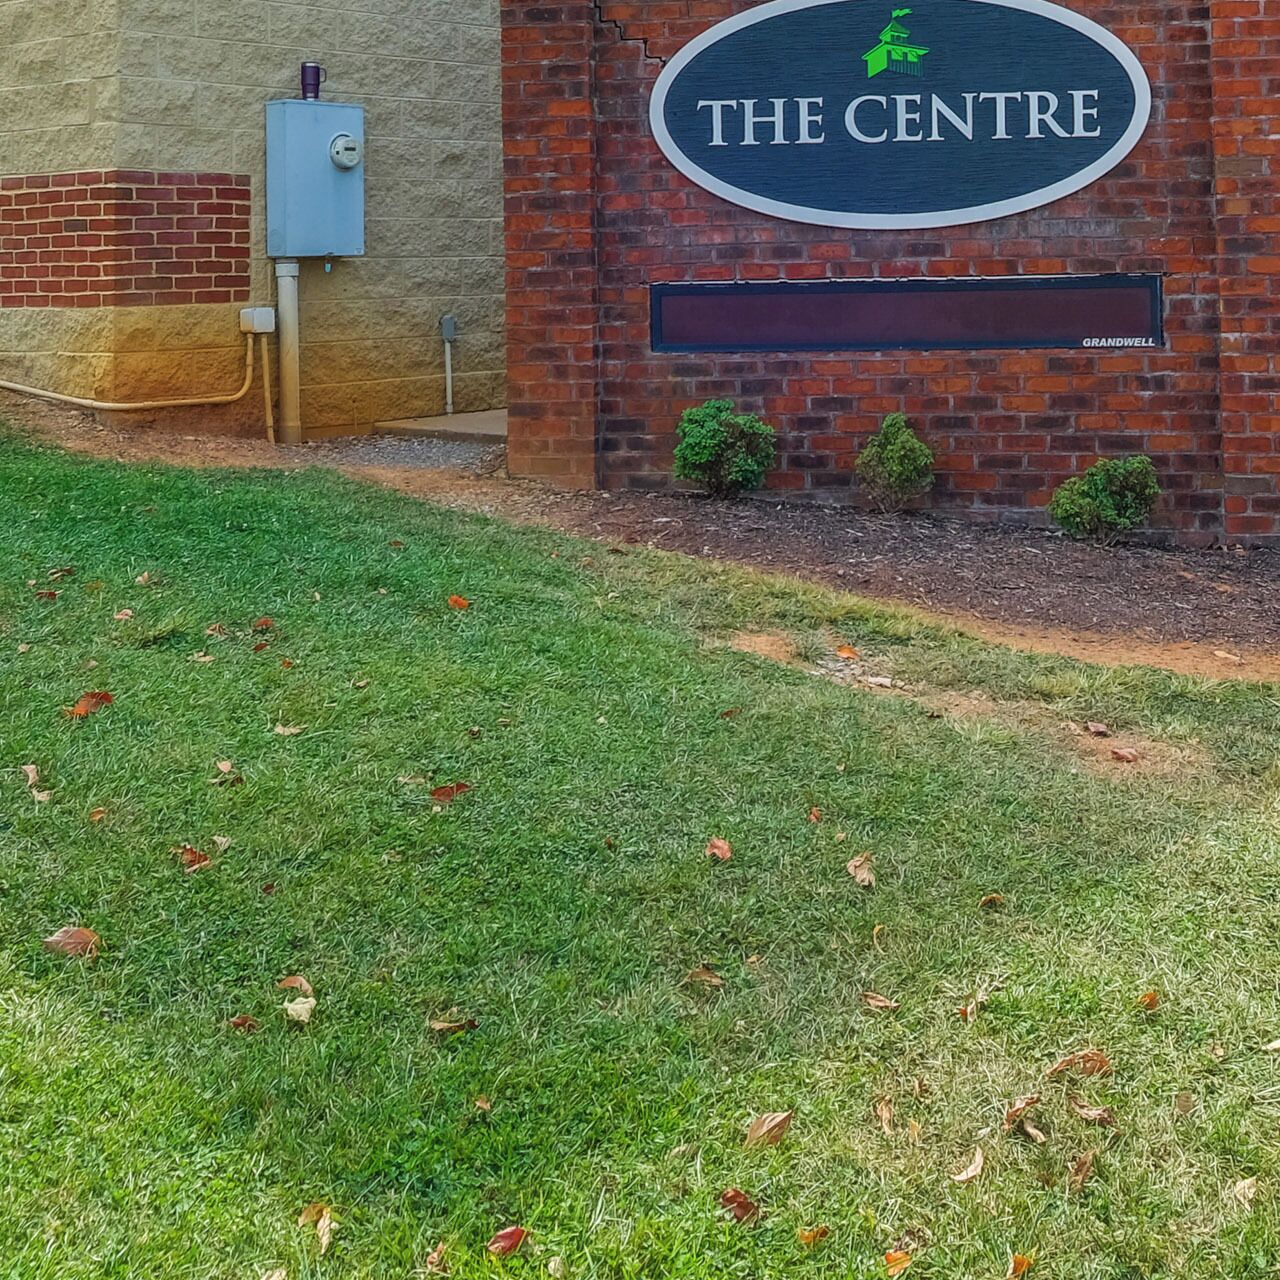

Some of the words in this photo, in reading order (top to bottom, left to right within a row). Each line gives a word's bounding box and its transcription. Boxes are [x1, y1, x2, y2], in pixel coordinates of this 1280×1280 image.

[696, 97, 825, 146] THE
[844, 89, 1101, 143] CENTRE
[1082, 337, 1156, 347] GRANDWELL
